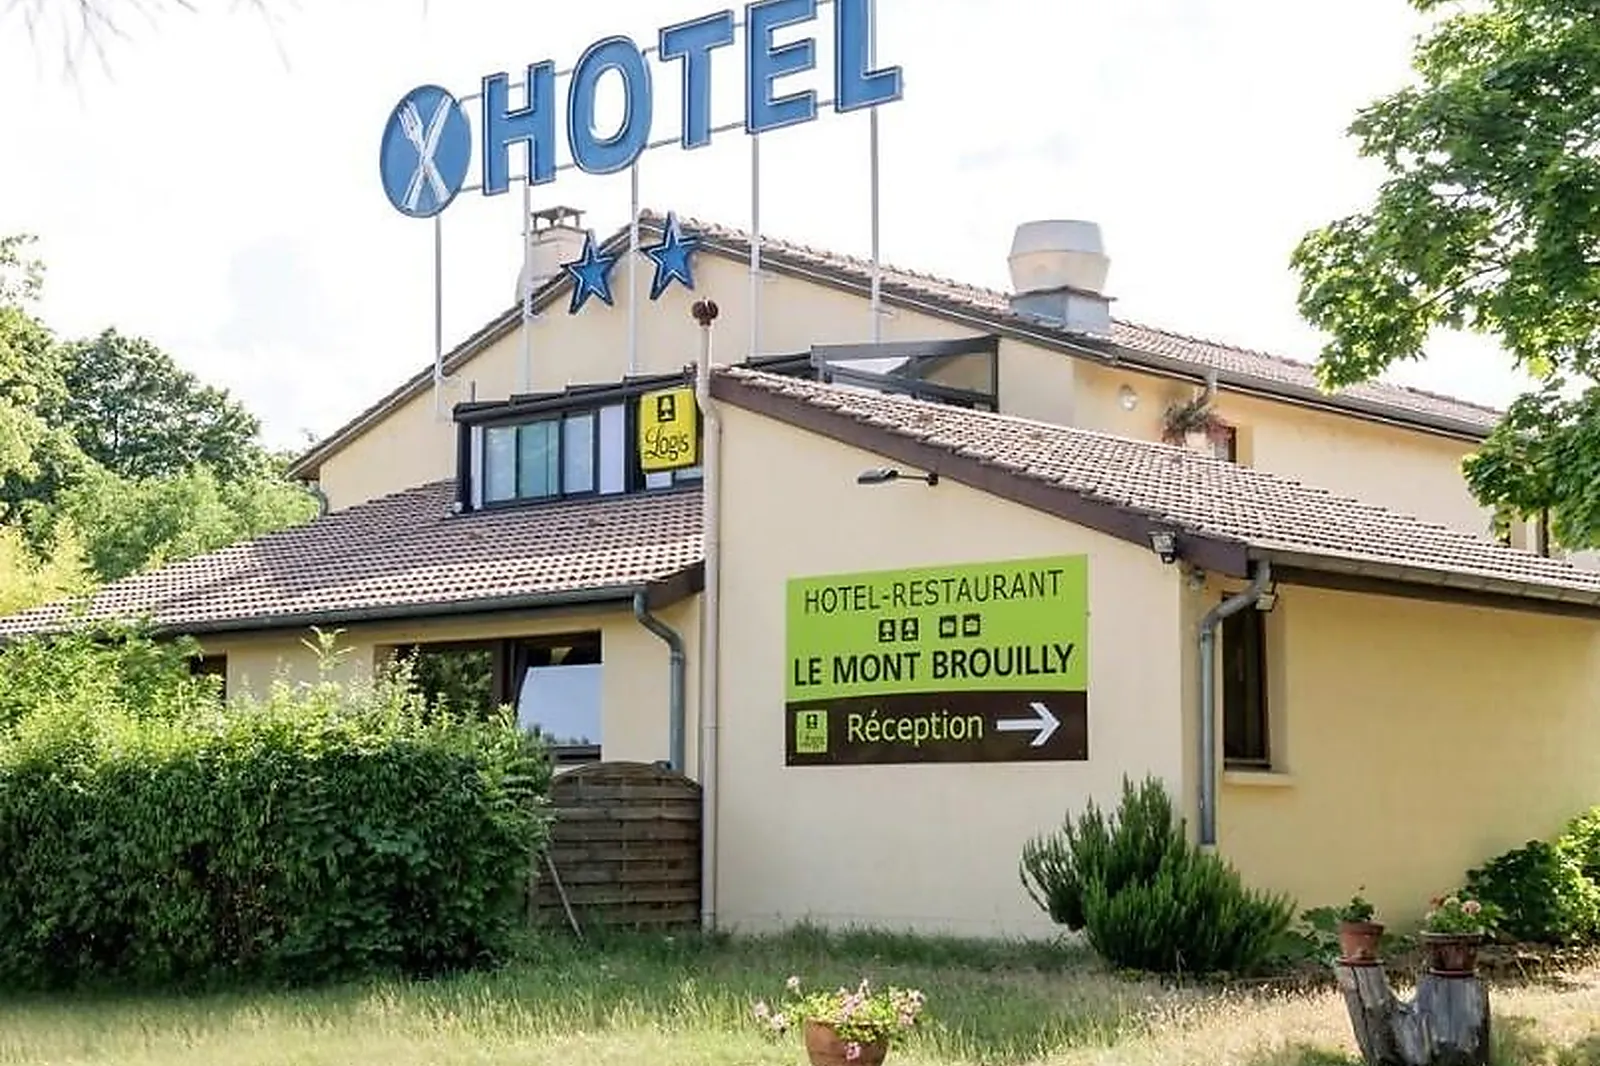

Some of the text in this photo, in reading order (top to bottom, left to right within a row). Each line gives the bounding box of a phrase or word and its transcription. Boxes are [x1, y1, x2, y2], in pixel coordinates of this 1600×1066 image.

[482, 0, 904, 195] HOTEL
[643, 424, 690, 462] Logis
[804, 569, 1064, 613] HOTEL-RESTAURANT
[794, 643, 1074, 686] LE MONT BROUILLY
[847, 710, 984, 746] Réception
